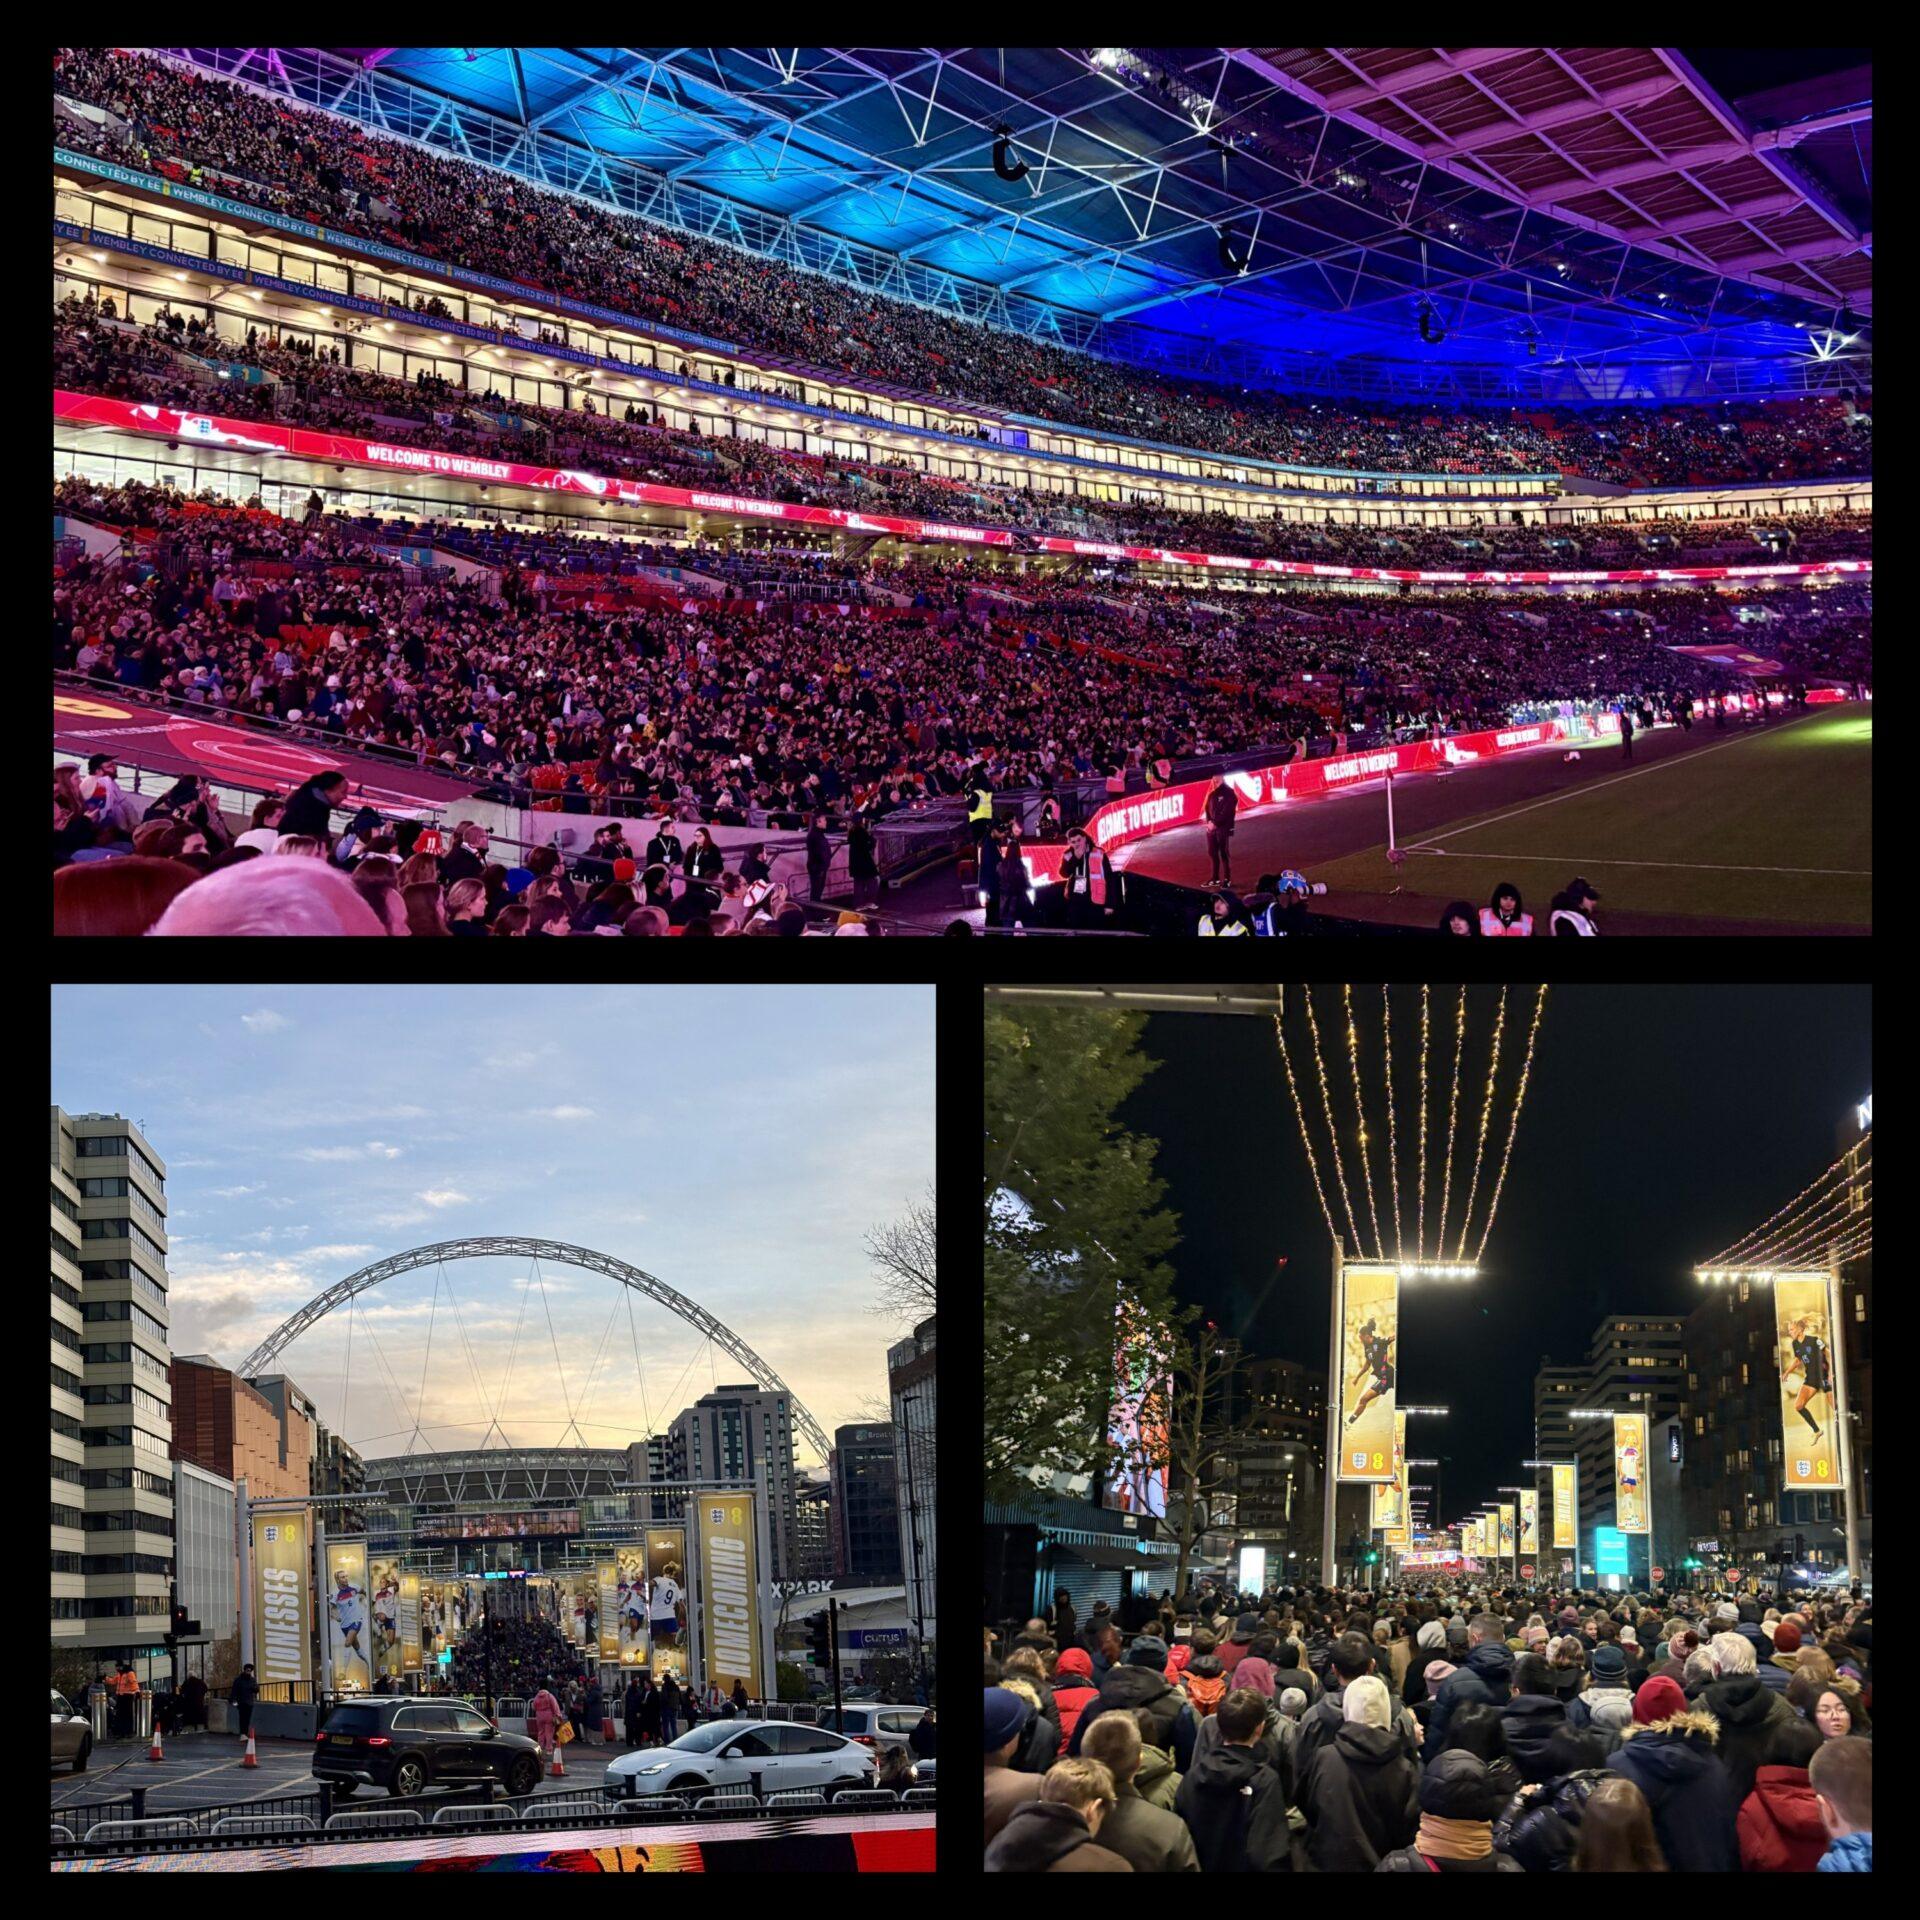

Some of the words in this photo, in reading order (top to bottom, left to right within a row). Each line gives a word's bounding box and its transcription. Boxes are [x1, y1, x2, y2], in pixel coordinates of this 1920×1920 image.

[55, 152, 129, 181] CONNECTED
[130, 174, 146, 188] BY
[147, 178, 160, 191] EE
[173, 186, 224, 210] WEMBLEY
[226, 204, 290, 228] CONNECTED
[291, 222, 304, 235] BY
[304, 226, 317, 237] EE
[66, 225, 80, 236] EE
[92, 233, 147, 254] WEMBLEY
[149, 248, 215, 273] CONNECTED
[216, 265, 230, 277] BY
[231, 268, 244, 280] EE
[326, 232, 369, 251] WEMBLEY
[370, 244, 423, 267] CONNECTED
[424, 260, 435, 270] BY
[435, 264, 445, 274] EE
[254, 275, 301, 294] WEMBLEY
[302, 287, 358, 308] CONNECTED
[358, 301, 370, 312] BY
[370, 304, 381, 314] EE
[453, 270, 490, 288] WEMBLEY
[490, 279, 535, 300] CONNECTED
[535, 291, 545, 302] BY
[545, 294, 555, 304] EE
[389, 309, 428, 326] WEMBLEY
[428, 318, 476, 337] CONNECTED
[477, 329, 487, 339] BY
[487, 332, 496, 341] EE
[561, 300, 593, 315] WEMBLEY
[593, 309, 633, 325] CONNECTED
[503, 334, 537, 350] WEMBLEY
[537, 343, 578, 361] CONNECTED
[602, 359, 631, 373] WEMBLEY
[367, 445, 431, 467] WELCOME
[433, 454, 449, 470] TO
[449, 456, 510, 479] WEMBLEY
[691, 493, 735, 511] WELCOME
[735, 499, 746, 513] TO
[745, 500, 784, 516] WEMBLEY
[1323, 758, 1359, 781] WELCOME
[1359, 757, 1369, 775] TO
[1127, 805, 1141, 831] TO
[1140, 793, 1184, 827] WEMBLEY
[601, 1584, 618, 1640] CHAMPIONS
[664, 1589, 674, 1605] 9
[709, 1536, 751, 1679] HOMECOMING
[263, 1567, 301, 1681] LIONESSES
[401, 1599, 418, 1646] EUROPEAN
[864, 1634, 899, 1645] currys
